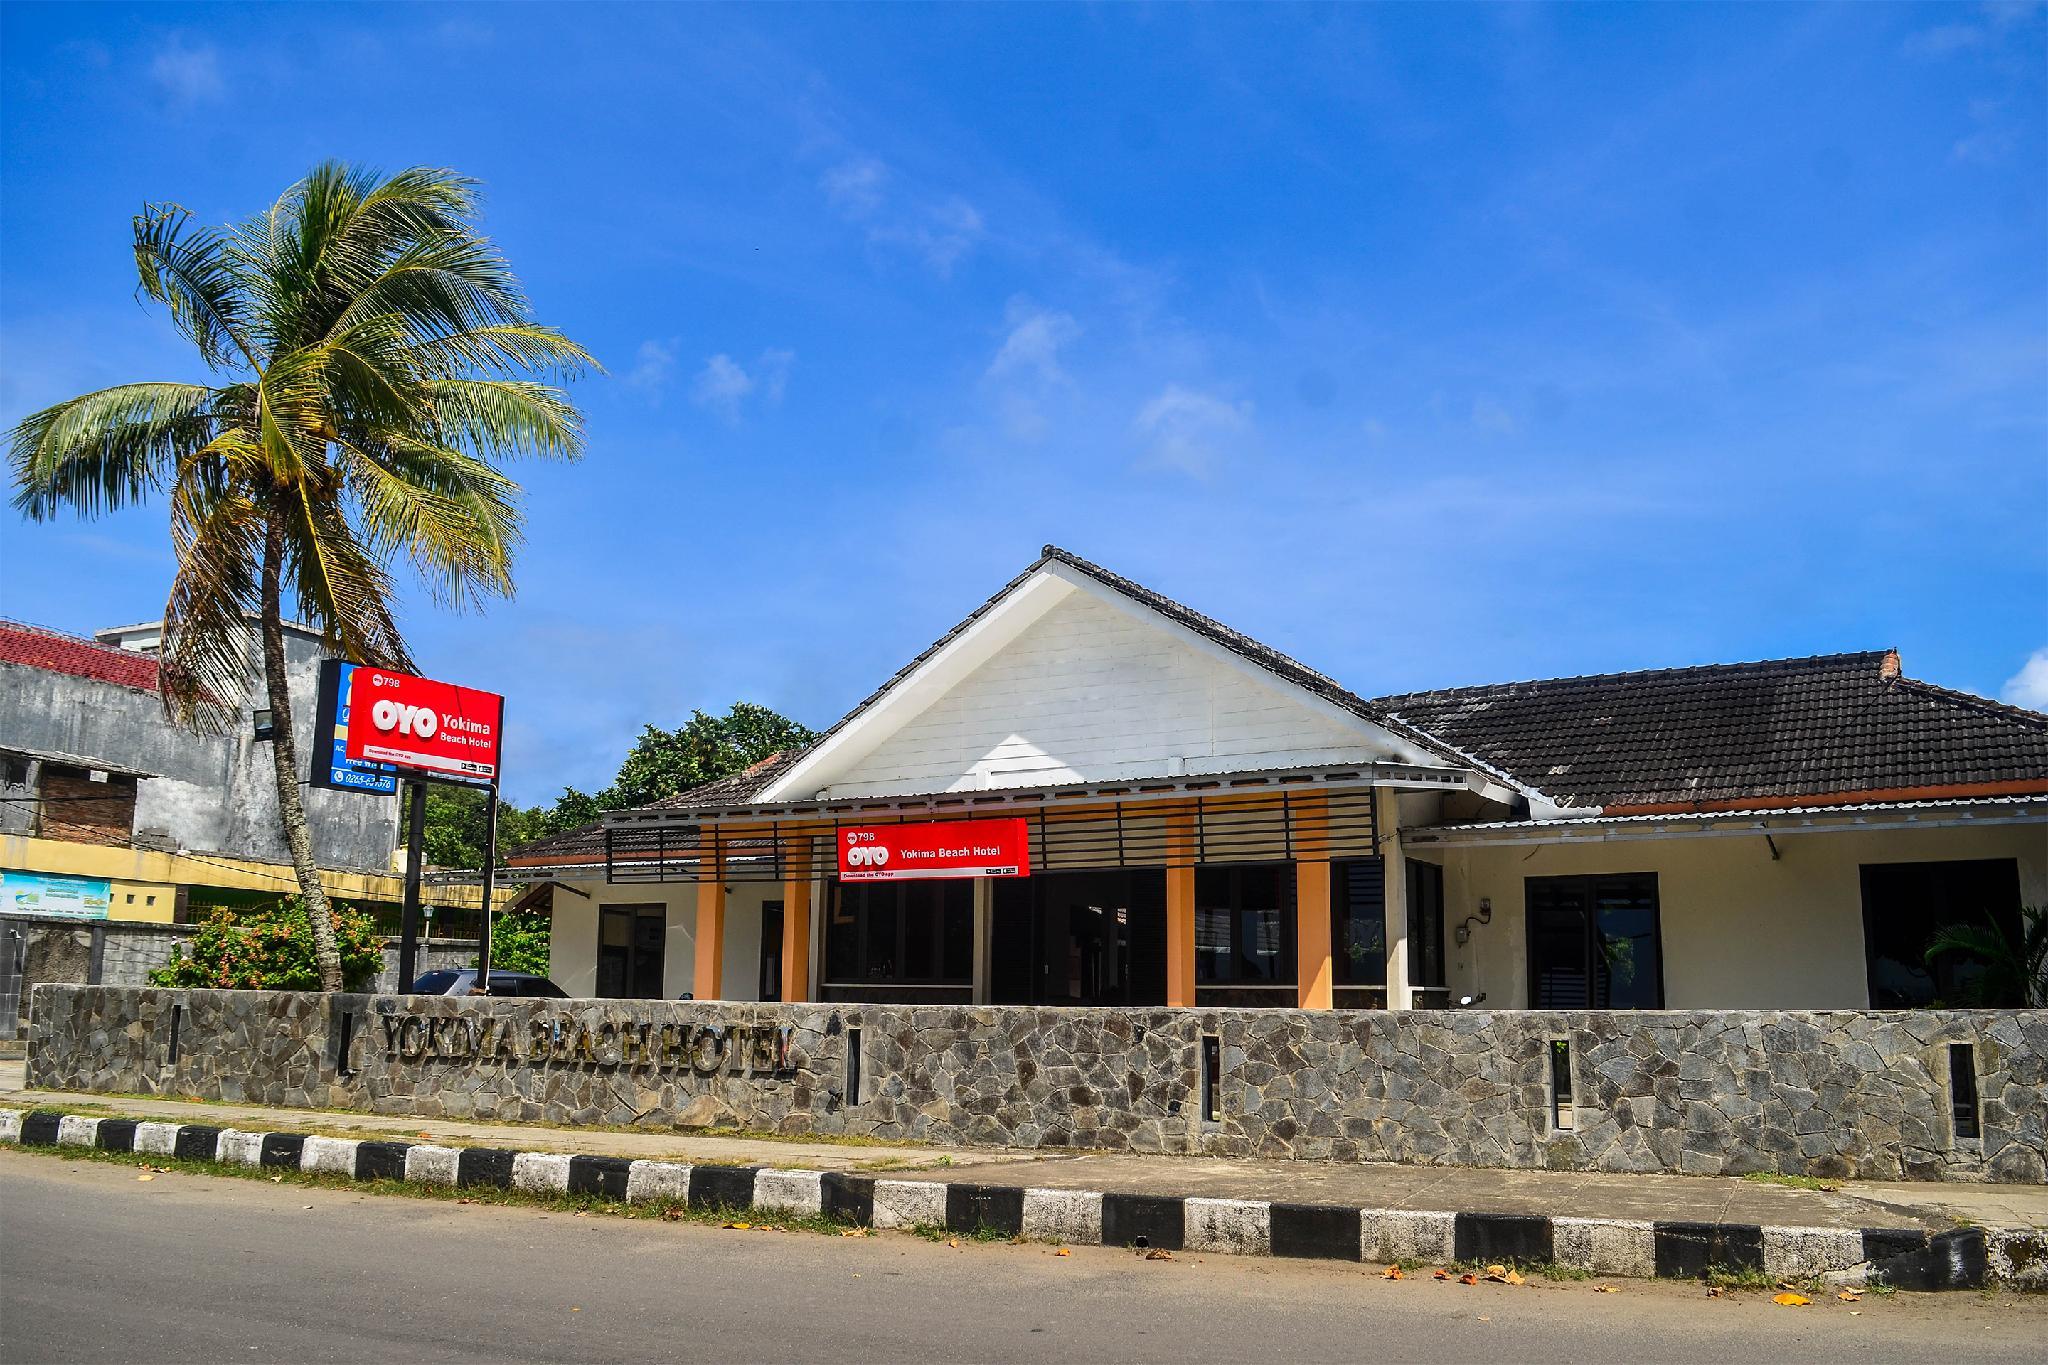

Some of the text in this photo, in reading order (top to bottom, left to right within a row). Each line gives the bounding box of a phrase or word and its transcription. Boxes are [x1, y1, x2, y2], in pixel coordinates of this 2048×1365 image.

[384, 677, 400, 688] 798
[372, 699, 438, 738] OYO
[442, 713, 491, 735] Yokima
[440, 731, 492, 749] Beach Hotel
[857, 832, 875, 842] 798
[847, 846, 889, 866] OYO
[901, 845, 1001, 859] Yokima Beach Hotel
[382, 1015, 800, 1073] YOKIMA BEACH HOTEL
